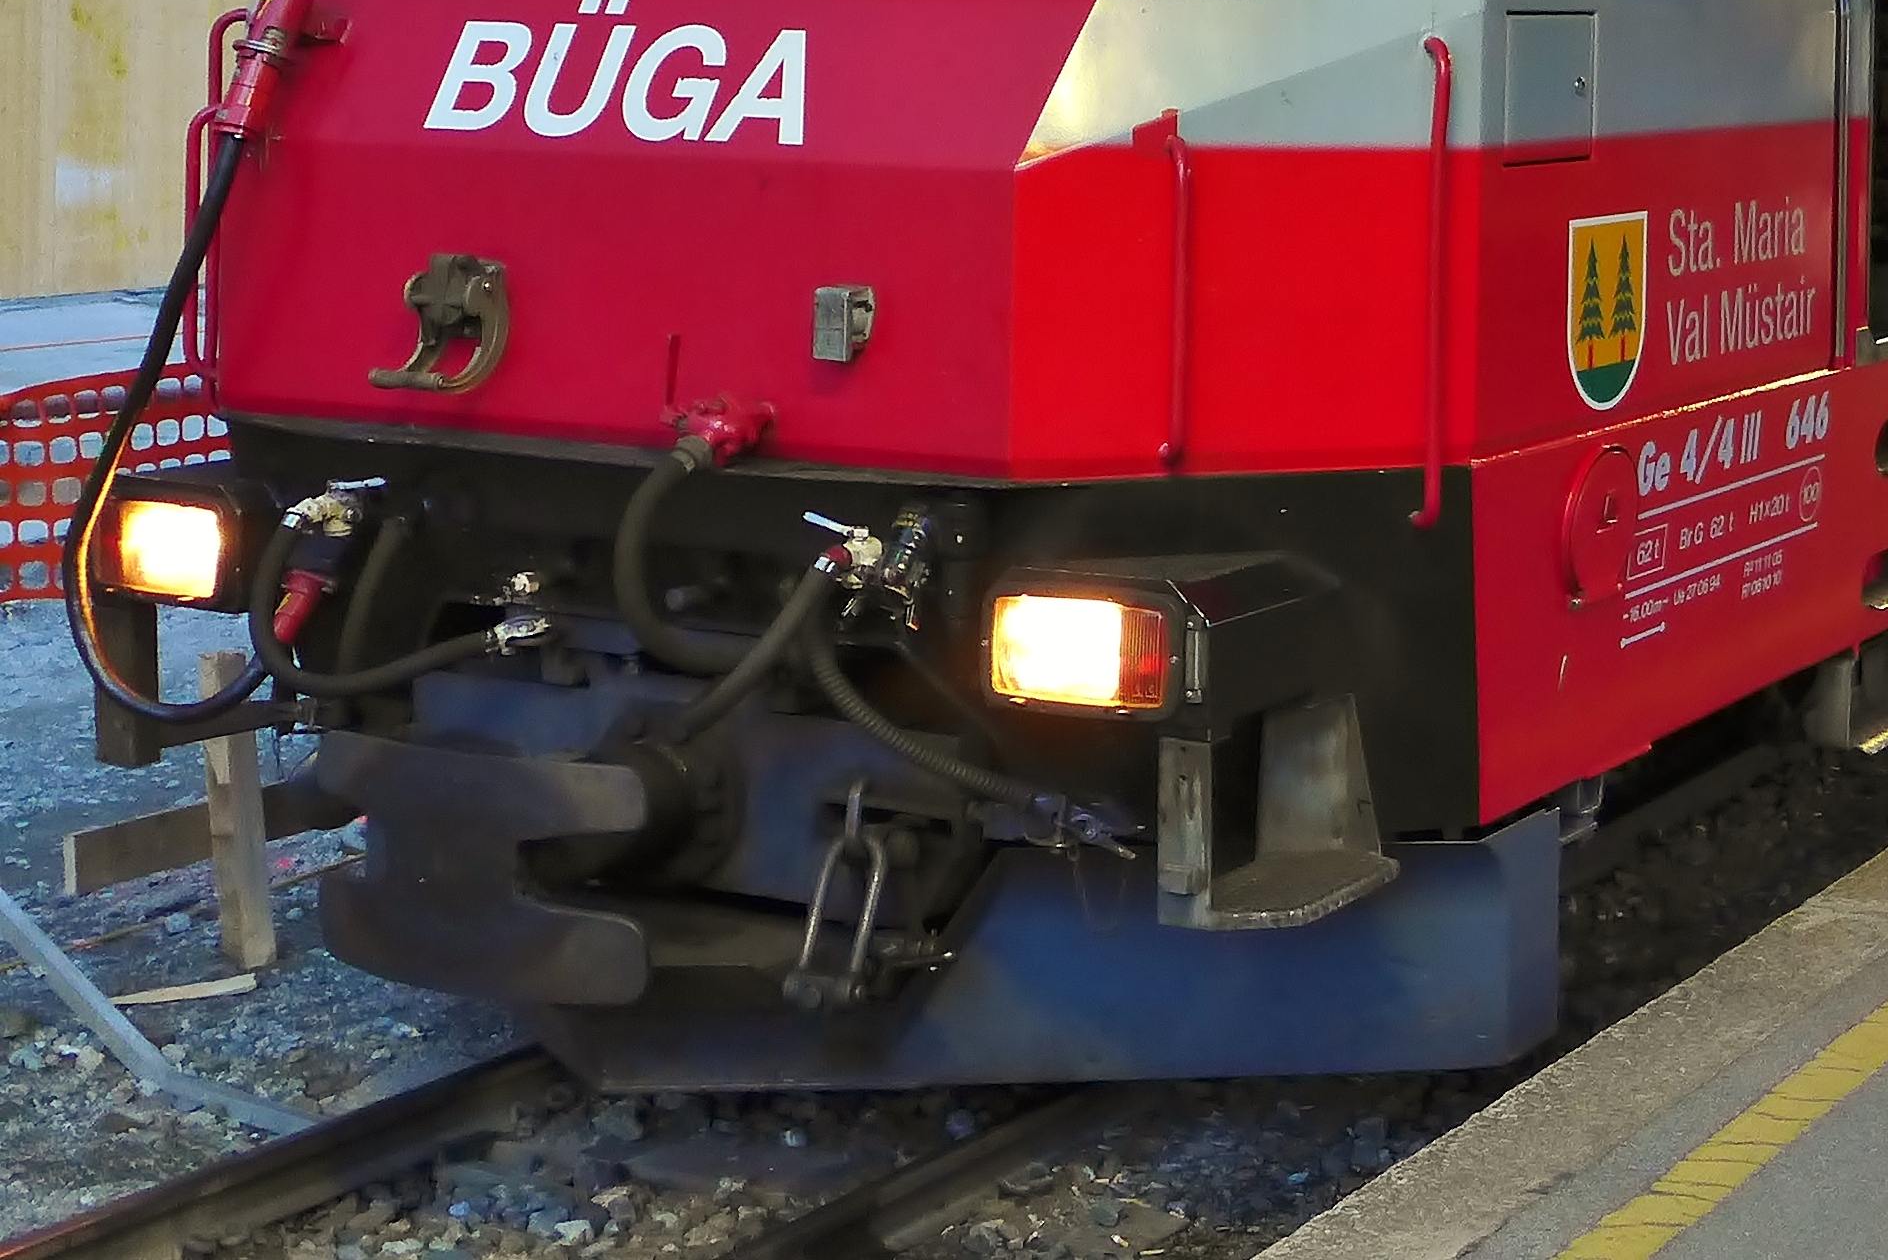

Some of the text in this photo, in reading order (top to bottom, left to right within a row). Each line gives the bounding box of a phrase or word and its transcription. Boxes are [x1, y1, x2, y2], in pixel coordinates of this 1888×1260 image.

[1667, 196, 1806, 277] Sta. Maria
[1667, 276, 1817, 366] Val Müstair
[1637, 441, 1671, 497] Ge
[1785, 391, 1830, 449] 646
